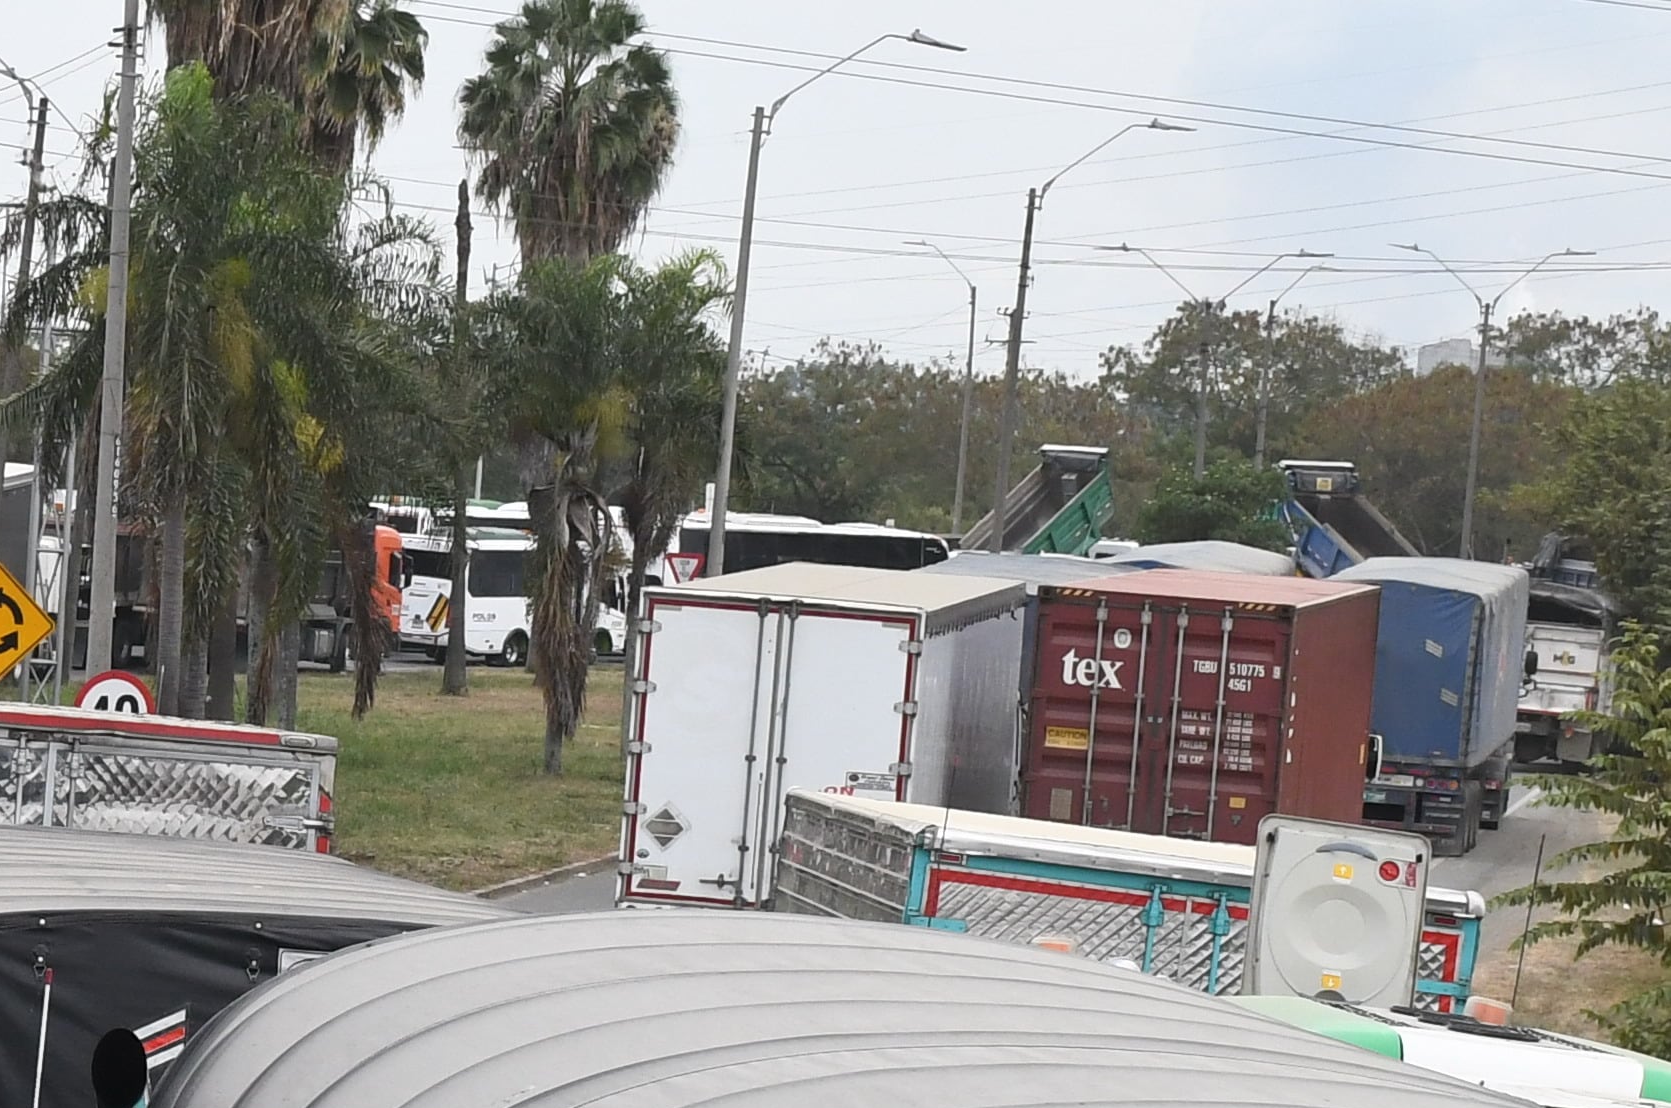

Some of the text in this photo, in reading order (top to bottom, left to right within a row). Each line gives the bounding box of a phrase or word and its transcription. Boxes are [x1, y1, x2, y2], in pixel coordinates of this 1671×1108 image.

[1061, 647, 1125, 690] tex
[1229, 662, 1266, 678] 510775
[1227, 678, 1252, 692] 45G1
[1047, 728, 1088, 741] CAUTION
